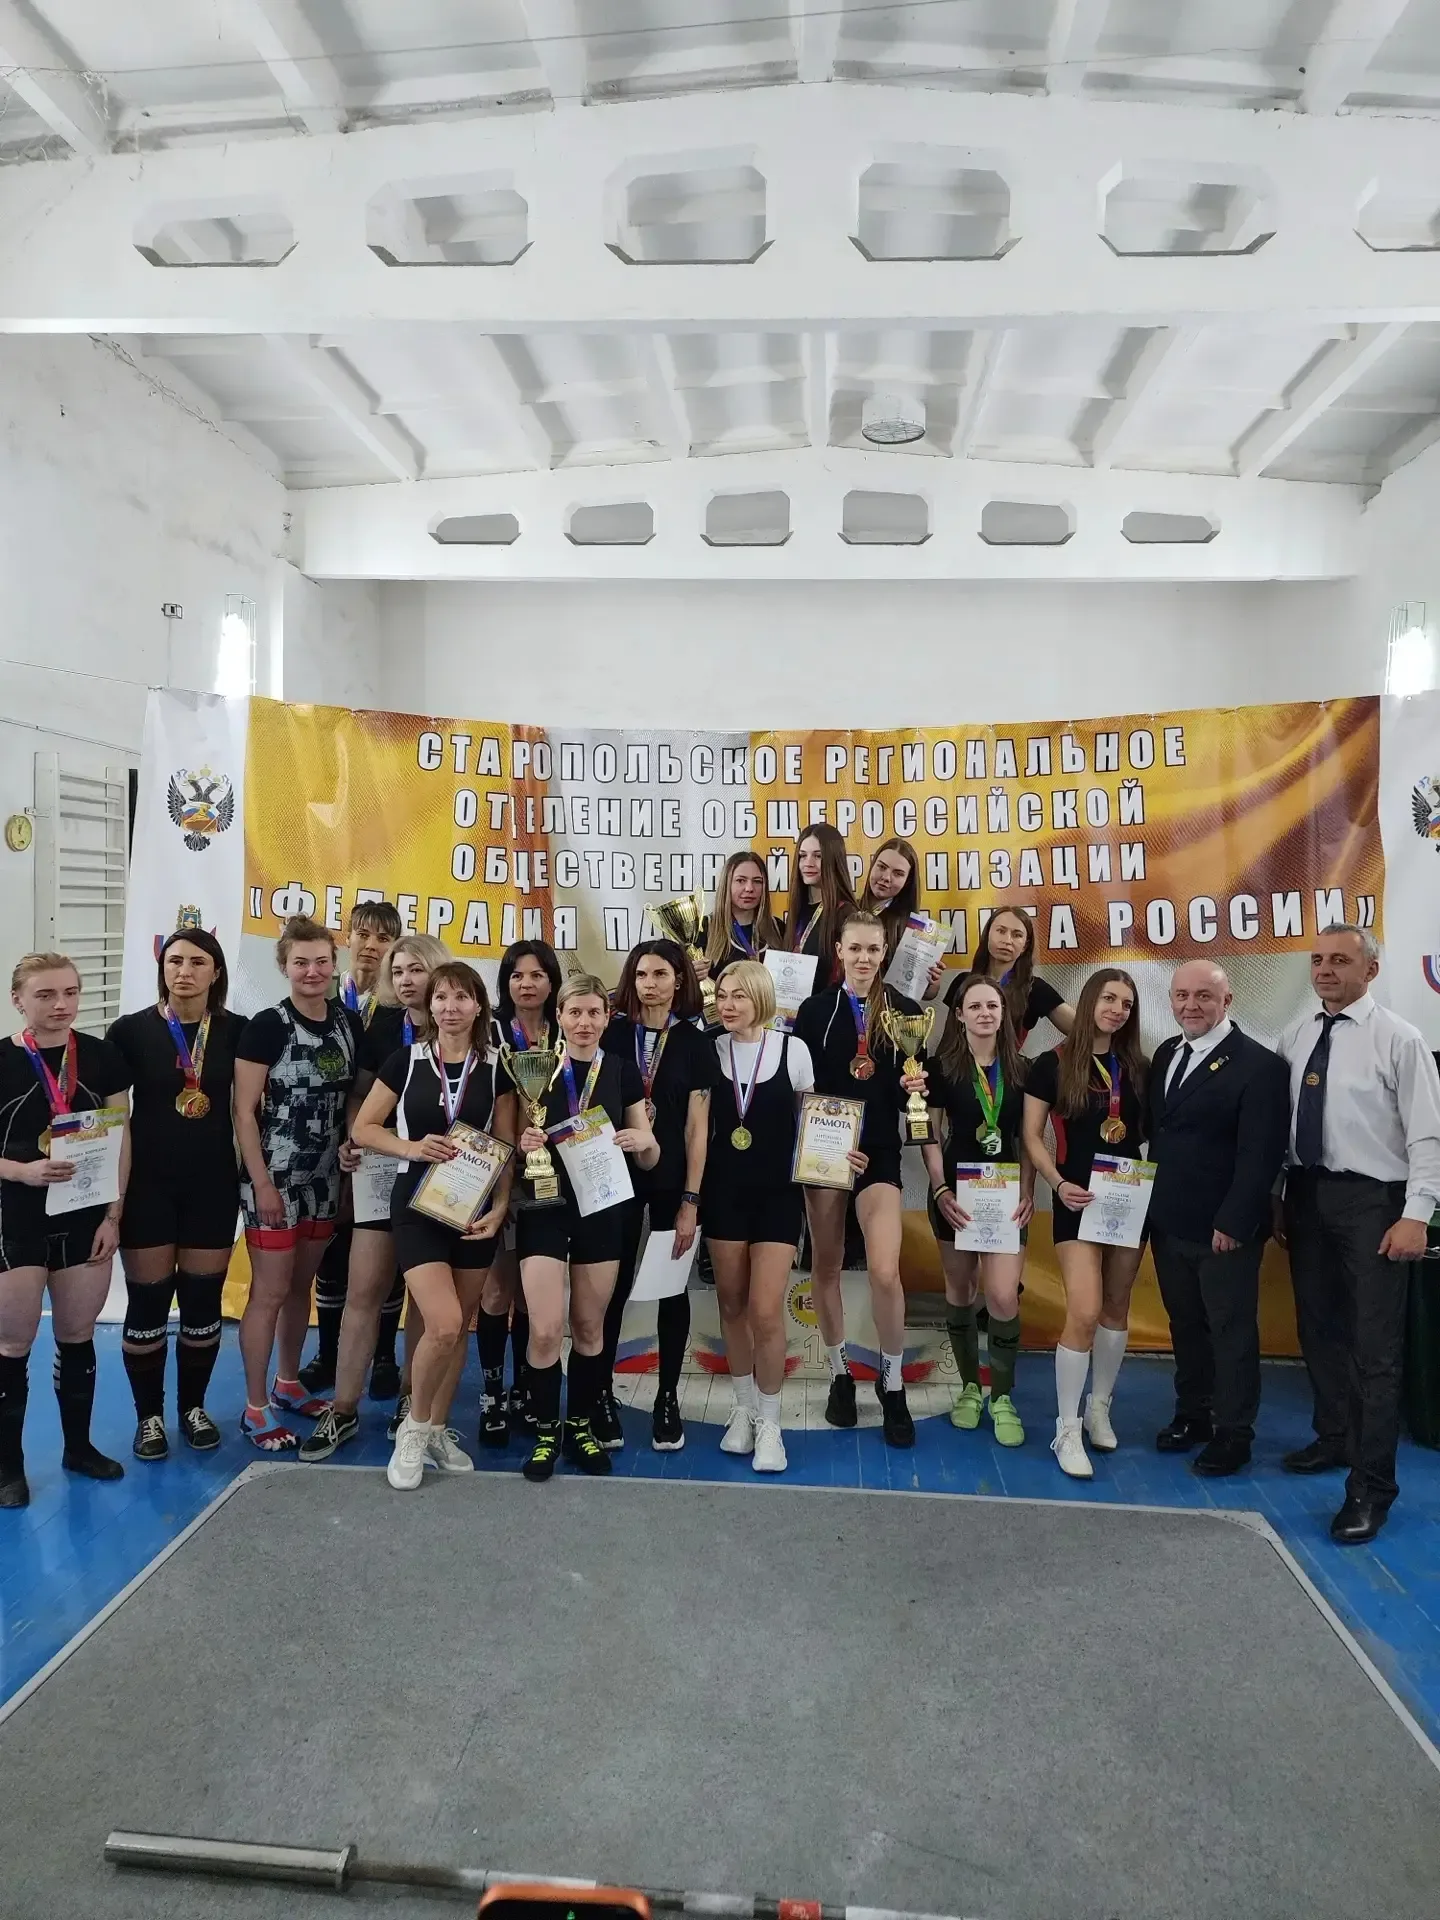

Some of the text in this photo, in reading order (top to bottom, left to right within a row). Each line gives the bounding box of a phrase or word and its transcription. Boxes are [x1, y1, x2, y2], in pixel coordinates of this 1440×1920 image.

[824, 726, 1187, 785] РЕГИОНАЛЬНОЕ
[453, 788, 682, 840] ОТЕЛЕНИЕ
[452, 843, 789, 895] ОБЩЕСТВЕННЙ
[1107, 887, 1376, 947] РОССИИ»
[809, 1116, 852, 1130] ГРАМОТА
